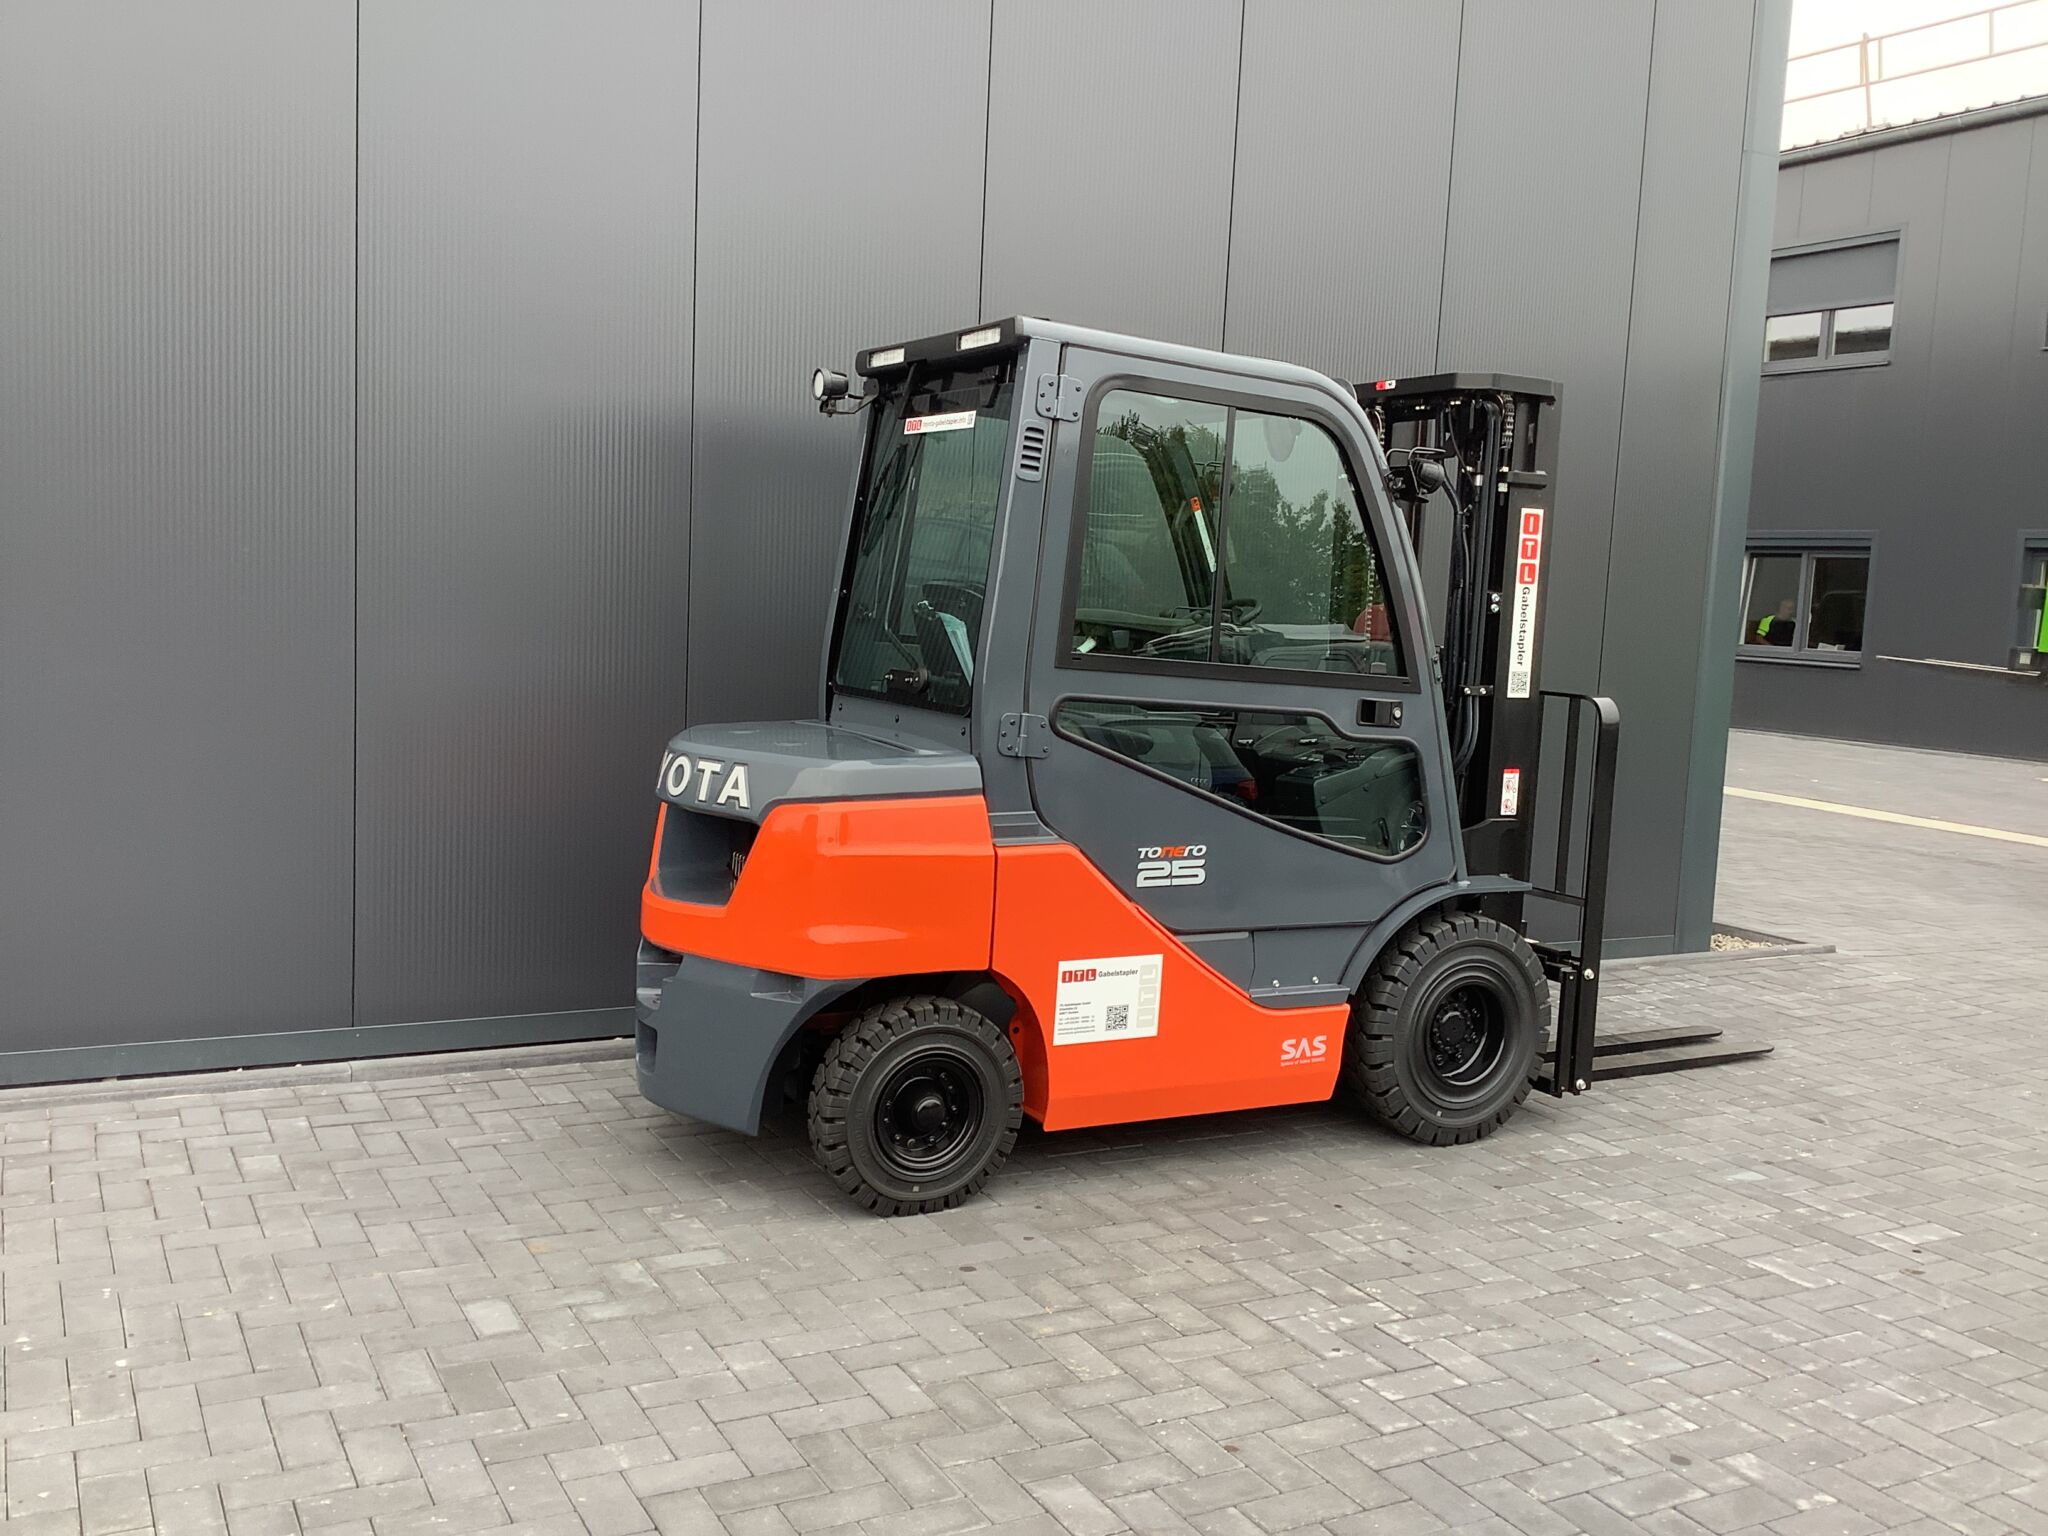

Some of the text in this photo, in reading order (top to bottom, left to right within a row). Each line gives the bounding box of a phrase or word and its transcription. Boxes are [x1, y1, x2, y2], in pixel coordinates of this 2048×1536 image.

[1516, 514, 1538, 666] ITL Gabelstapler
[1136, 858, 1206, 888] 25
[1063, 969, 1139, 983] ITL Gabelstapler
[1280, 1035, 1327, 1060] SAS
